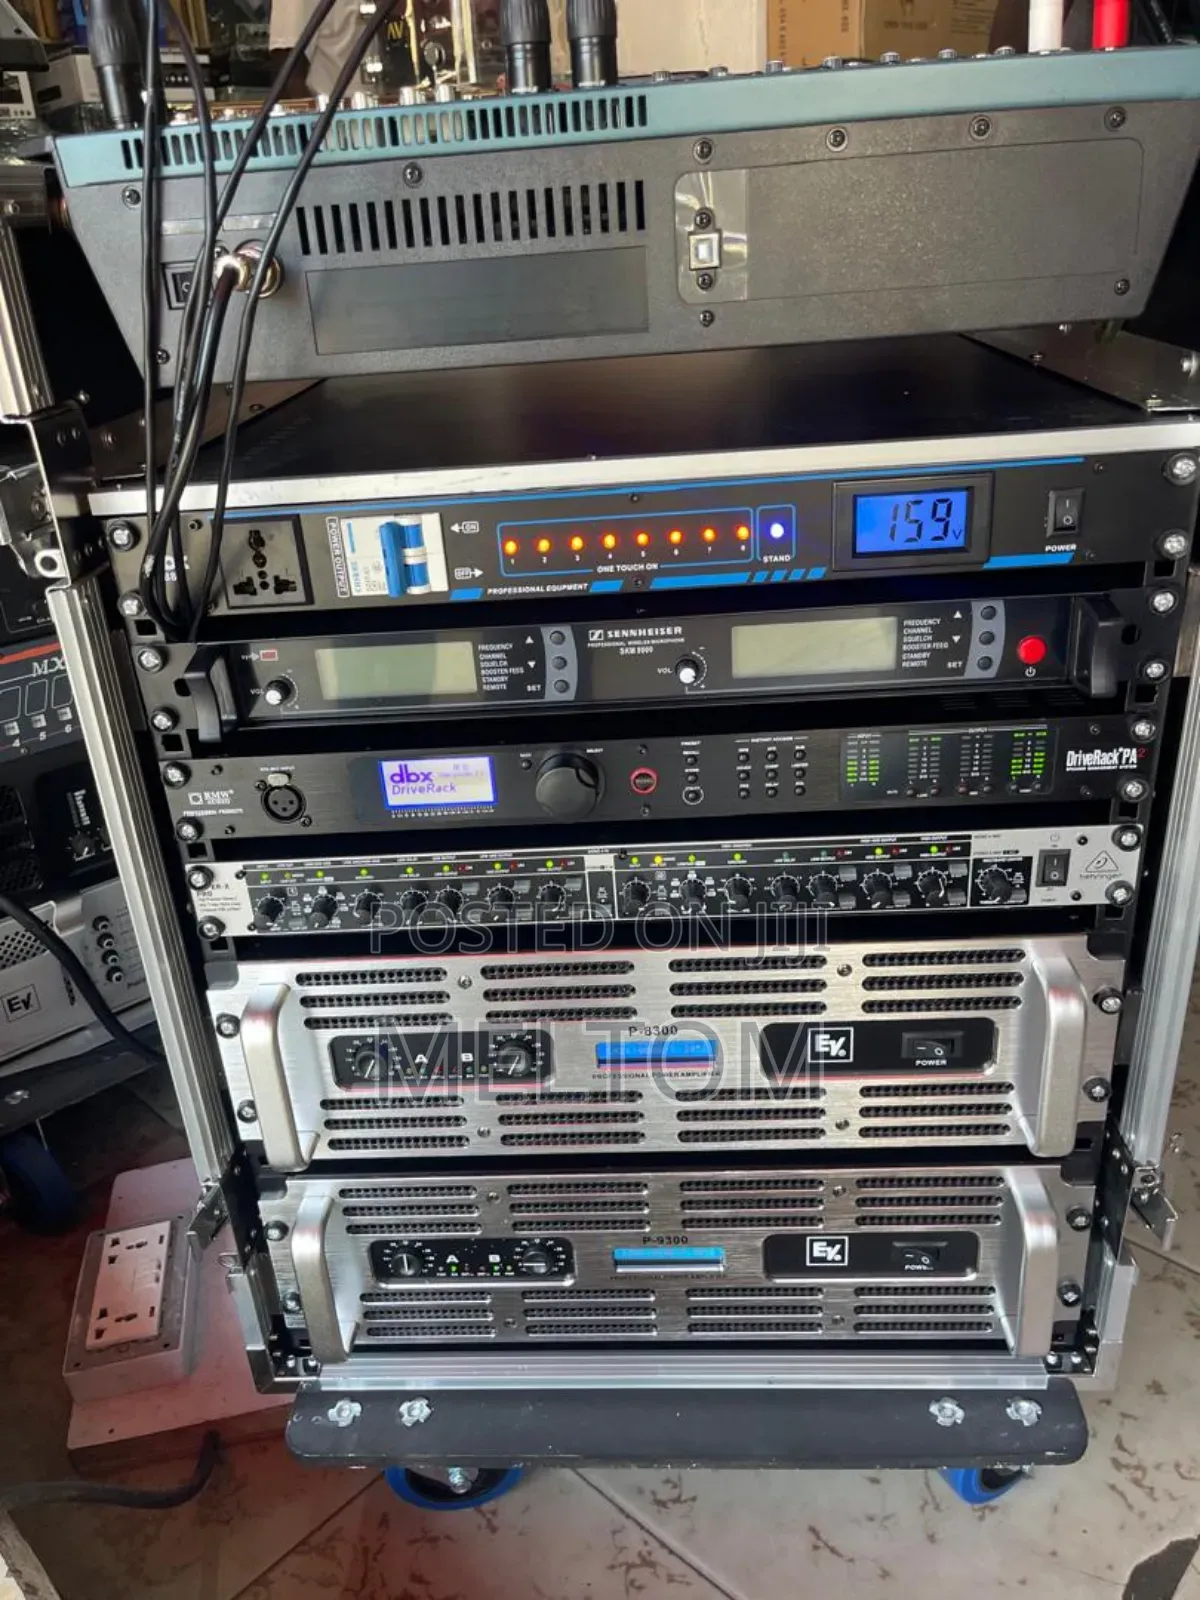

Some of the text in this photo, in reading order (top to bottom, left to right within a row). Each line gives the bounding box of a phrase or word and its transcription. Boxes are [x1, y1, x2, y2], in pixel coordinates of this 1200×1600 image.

[1045, 543, 1077, 552] POWER
[763, 554, 791, 564] STAND
[597, 562, 659, 573] ONE TOUCH ON
[487, 586, 545, 595] PROFESSIONAL
[606, 626, 683, 638] SENNHEISER
[903, 627, 934, 635] CHANNEL
[902, 660, 928, 668] REMOTE
[947, 661, 963, 669] SET
[657, 667, 672, 675] VOL
[483, 683, 507, 691] REMOTE
[526, 684, 542, 692] SET
[390, 763, 433, 784] dbx
[392, 782, 457, 796] DriveRack
[414, 1054, 429, 1064] A
[461, 1053, 475, 1062] B
[445, 1254, 460, 1264] A
[488, 1254, 501, 1263] B
